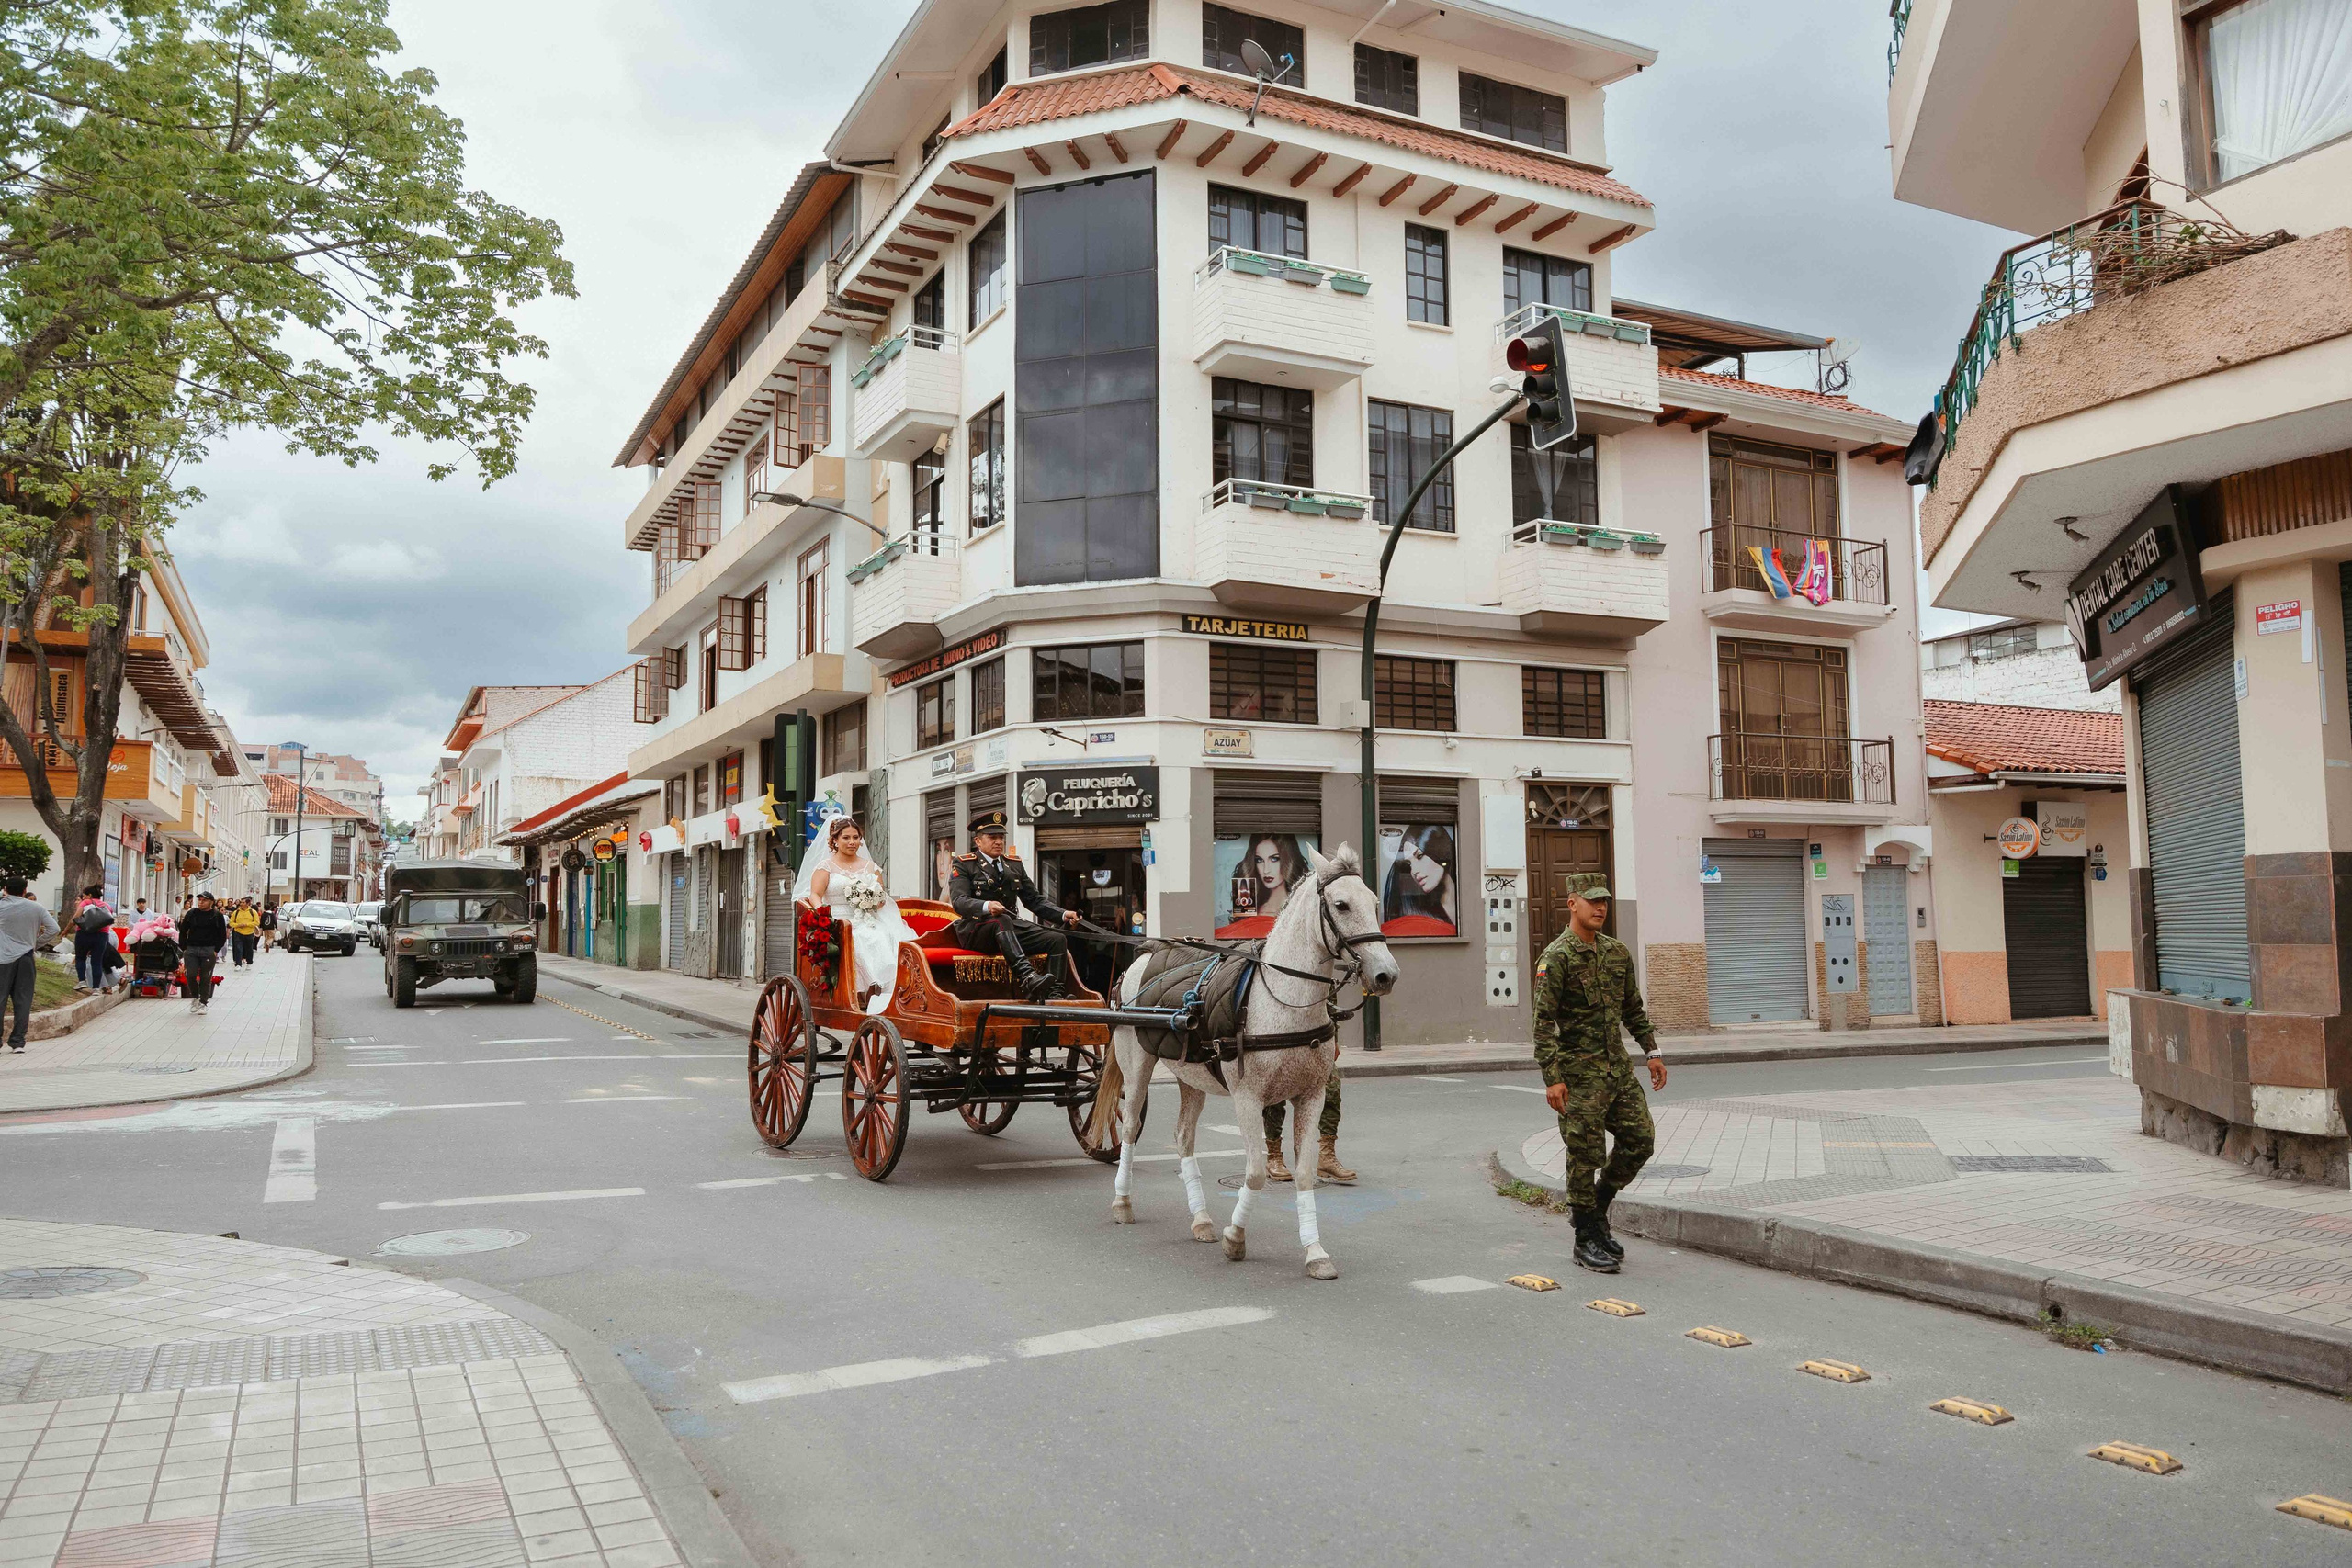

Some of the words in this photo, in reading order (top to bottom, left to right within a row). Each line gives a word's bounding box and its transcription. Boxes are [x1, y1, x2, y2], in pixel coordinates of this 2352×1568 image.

[2079, 576, 2109, 622] DENTAL
[2105, 557, 2128, 599] CARE
[2124, 527, 2160, 581] CENTER
[2258, 602, 2298, 614] PELIGRO
[1187, 616, 1307, 639] TARJETERIA
[891, 662, 930, 687] PRODUCTORA
[931, 658, 941, 673] DE
[943, 648, 965, 667] AUDIO
[972, 633, 998, 653] VIDEO
[54, 674, 68, 724] Aguinsaca
[1214, 739, 1241, 747] AZUAY
[1063, 773, 1136, 790] PELUQUERÍA
